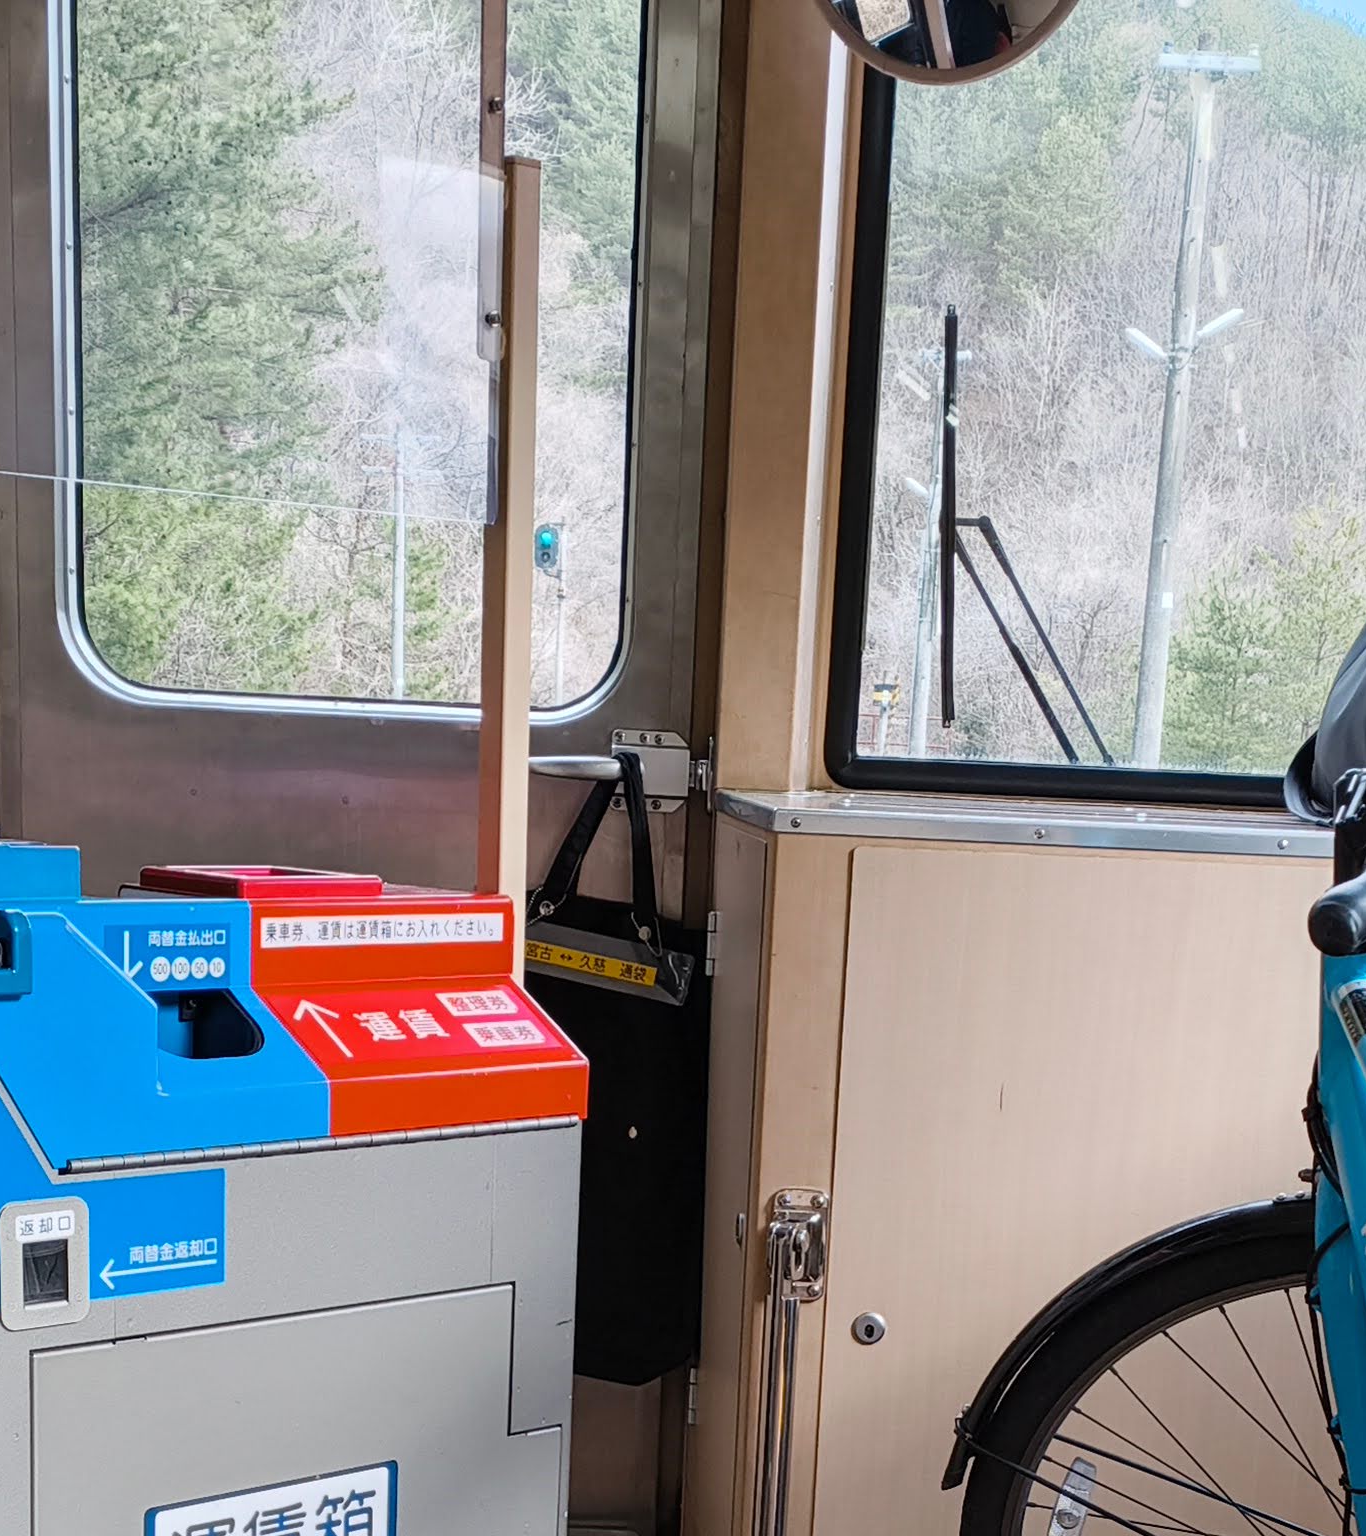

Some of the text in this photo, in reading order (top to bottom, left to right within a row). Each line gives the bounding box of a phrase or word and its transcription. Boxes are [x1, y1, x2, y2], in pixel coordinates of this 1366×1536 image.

[147, 928, 227, 948] 両替金払出口
[264, 918, 496, 943] 乗車券、運賃は運賃箱にお入れください。
[525, 942, 553, 961] 宮古
[152, 962, 168, 976] 500
[174, 962, 188, 976] 100
[444, 995, 509, 1012] 整理券
[351, 1008, 452, 1043] 運賃
[472, 1025, 537, 1043] 乗車券
[19, 1215, 72, 1236] 返却口
[128, 1237, 219, 1265] 両替金返却口
